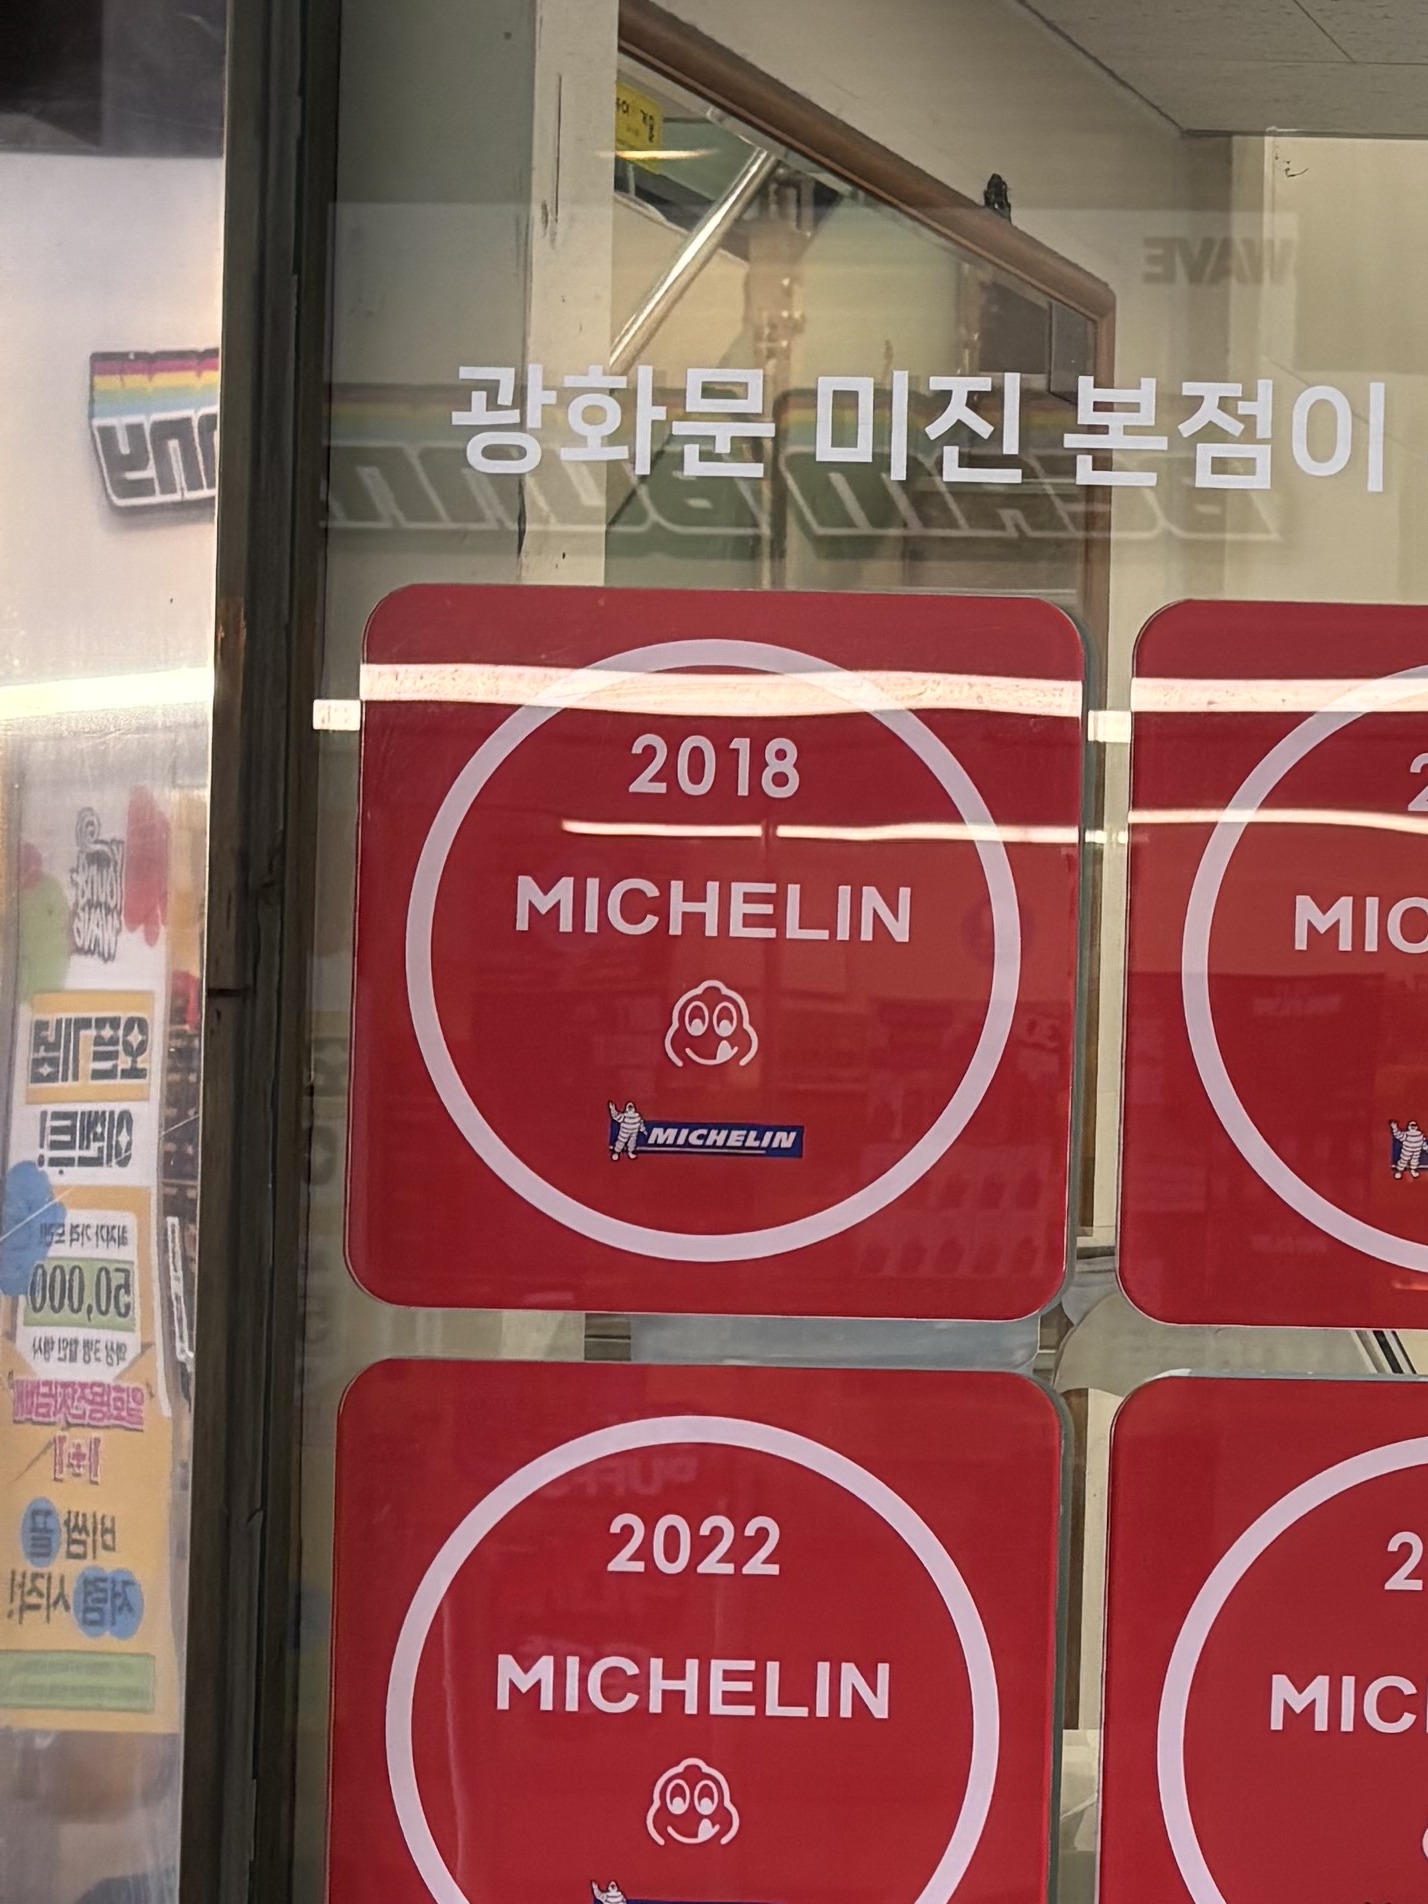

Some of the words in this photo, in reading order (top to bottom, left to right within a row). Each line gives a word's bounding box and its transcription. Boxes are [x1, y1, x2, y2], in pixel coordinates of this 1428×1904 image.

[452, 363, 775, 479] 광화문
[814, 369, 1022, 484] 미진
[1063, 375, 1385, 493] 본점이
[629, 733, 800, 798] 2018
[515, 874, 911, 943] MICHELIN
[646, 1126, 796, 1150] MICHELIN
[606, 1513, 780, 1576] 2022
[496, 1653, 889, 1719] MICHELIN
